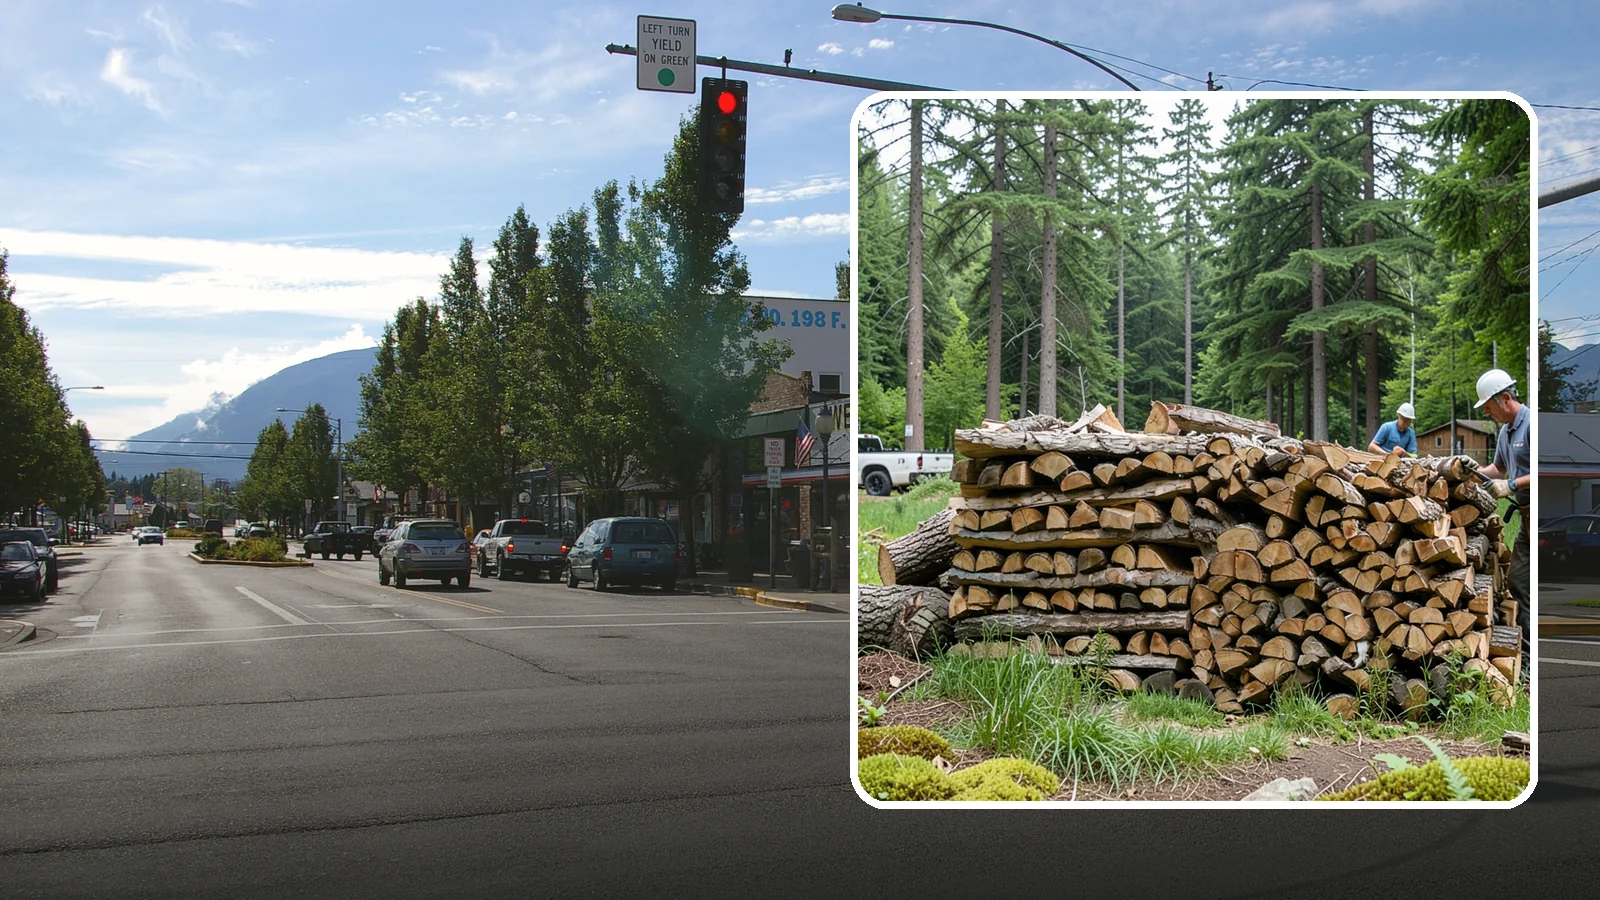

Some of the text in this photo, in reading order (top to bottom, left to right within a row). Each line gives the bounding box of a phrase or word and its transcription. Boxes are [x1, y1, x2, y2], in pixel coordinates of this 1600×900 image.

[643, 24, 690, 36] LEFT TURN
[652, 38, 682, 51] YIELD
[644, 53, 689, 66] ON GREEN
[791, 309, 826, 328] 198
[831, 311, 846, 329] F.
